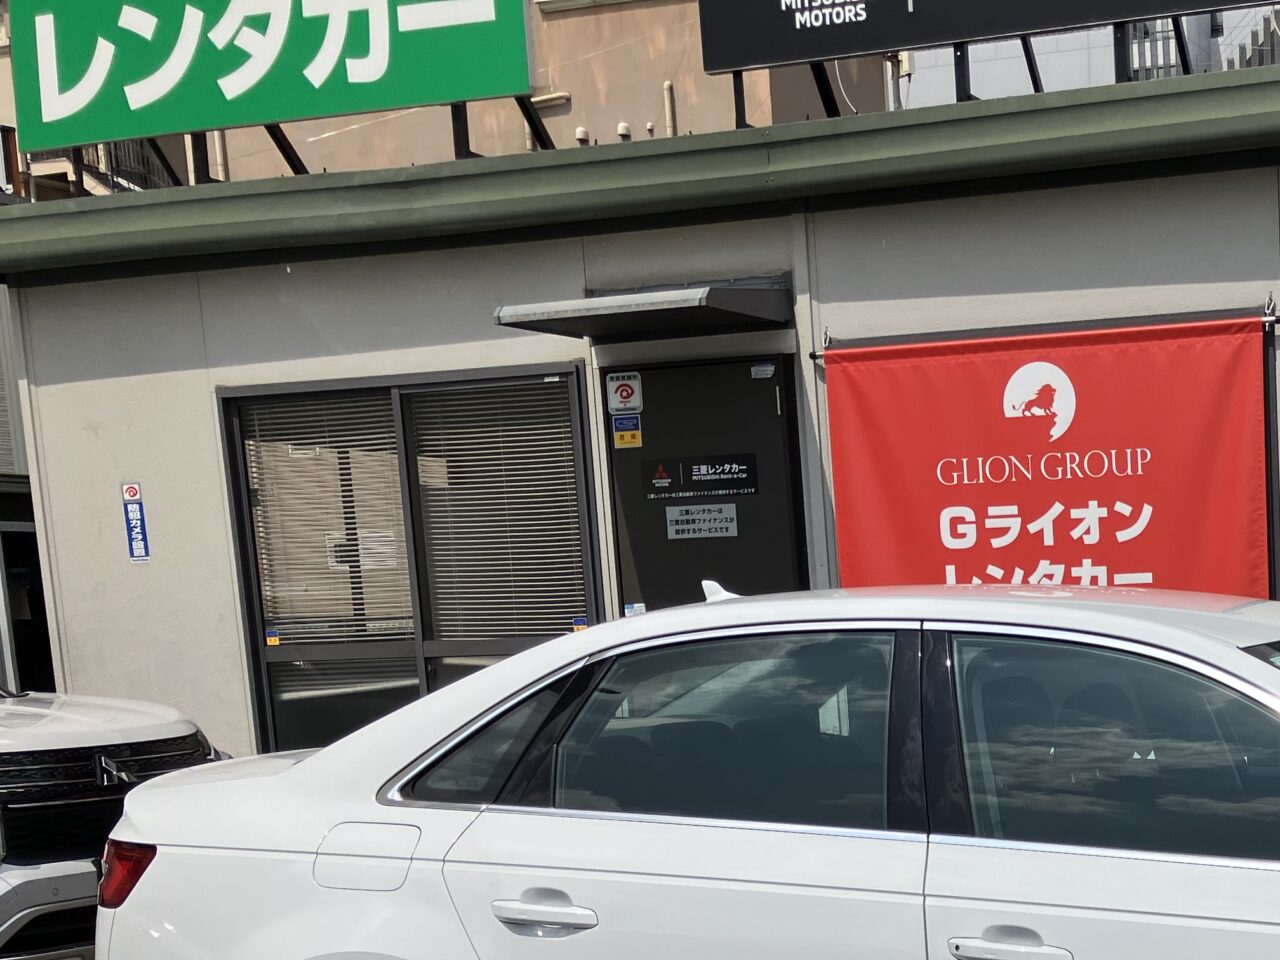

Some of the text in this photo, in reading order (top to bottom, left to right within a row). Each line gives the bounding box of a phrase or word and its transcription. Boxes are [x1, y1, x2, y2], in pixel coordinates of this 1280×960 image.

[795, 3, 867, 29] MOTORS
[35, 0, 496, 123] レンタカー
[936, 447, 1152, 486] GLION GROUP
[939, 500, 1153, 549] Gライオン
